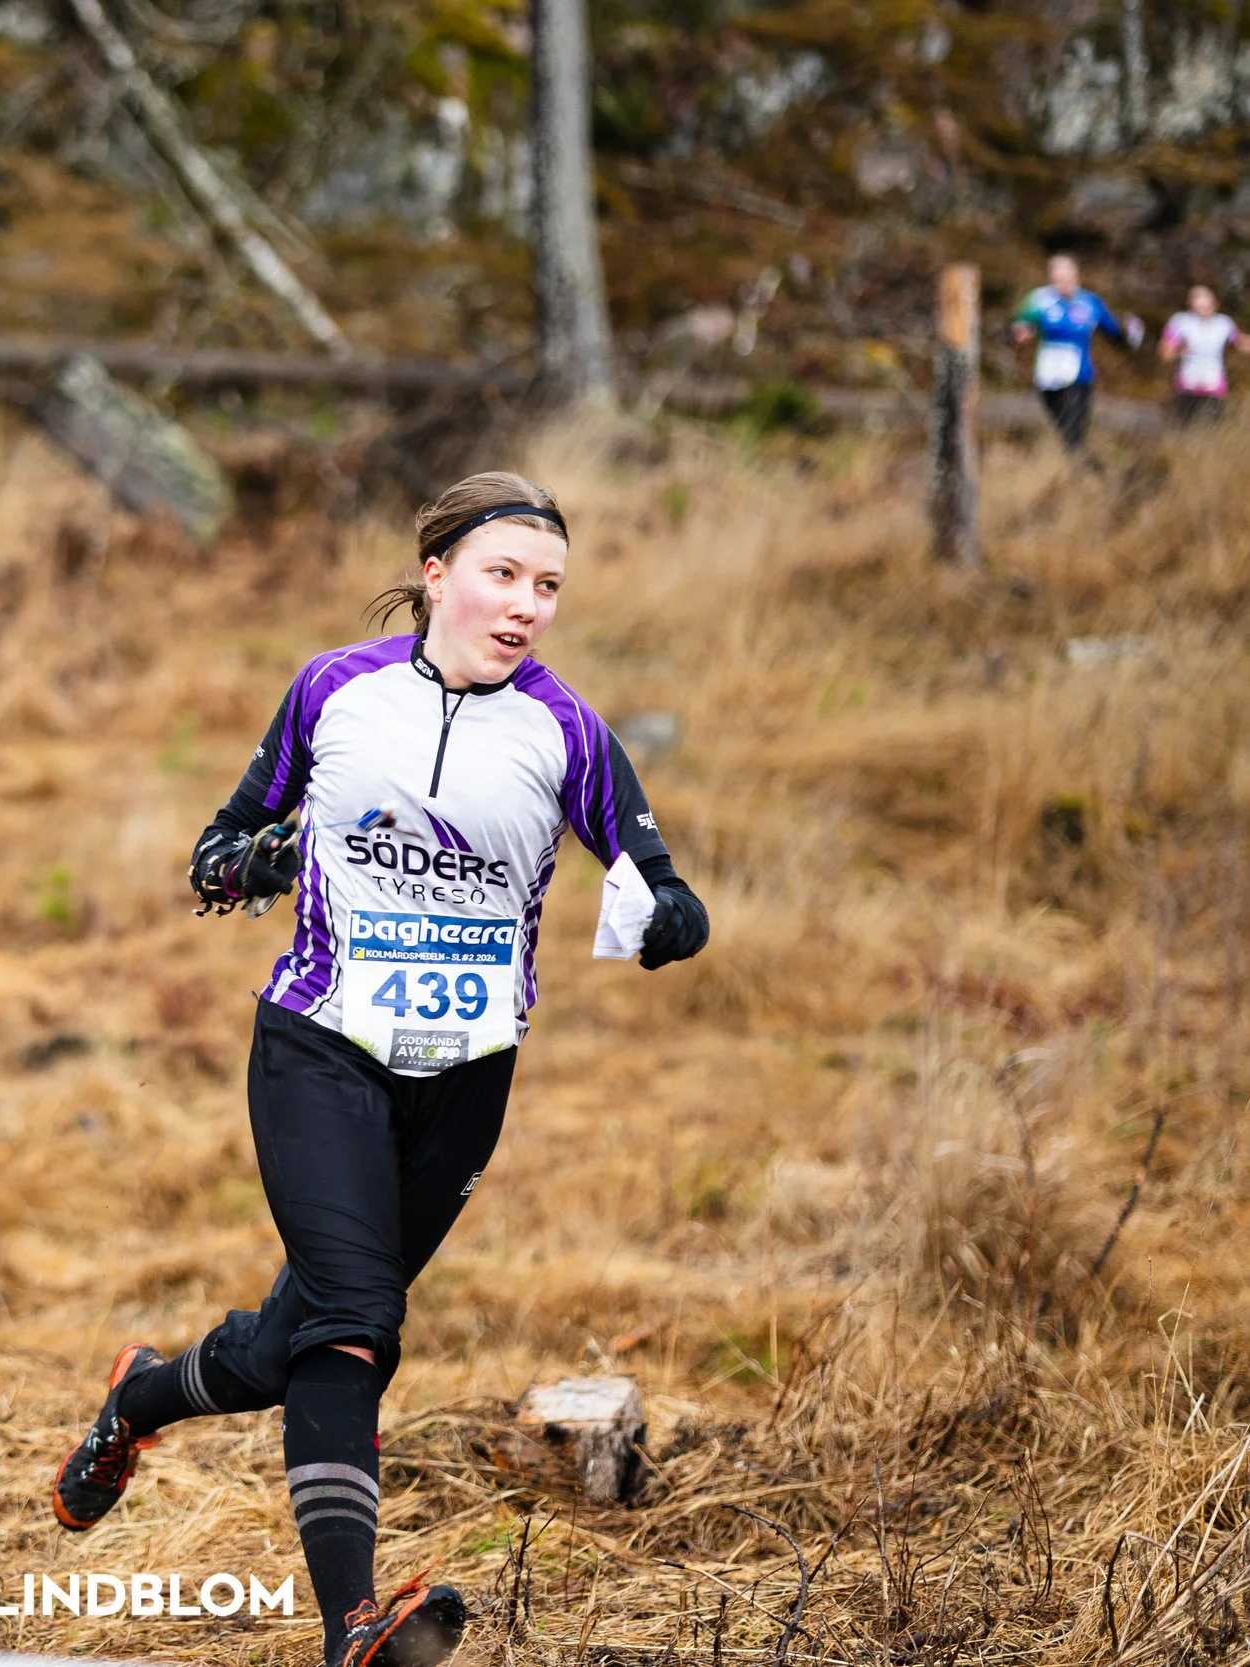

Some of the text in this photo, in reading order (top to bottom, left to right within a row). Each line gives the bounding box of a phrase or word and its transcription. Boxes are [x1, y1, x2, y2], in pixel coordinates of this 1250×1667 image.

[344, 833, 510, 888] SÖDERS
[372, 875, 486, 905] TYRESÖ
[351, 913, 516, 947] bagheera
[451, 954, 461, 962] SL
[461, 954, 474, 962] #2
[476, 954, 497, 963] 2026
[371, 969, 489, 1020] 439
[398, 1034, 462, 1047] GODKÄNDA
